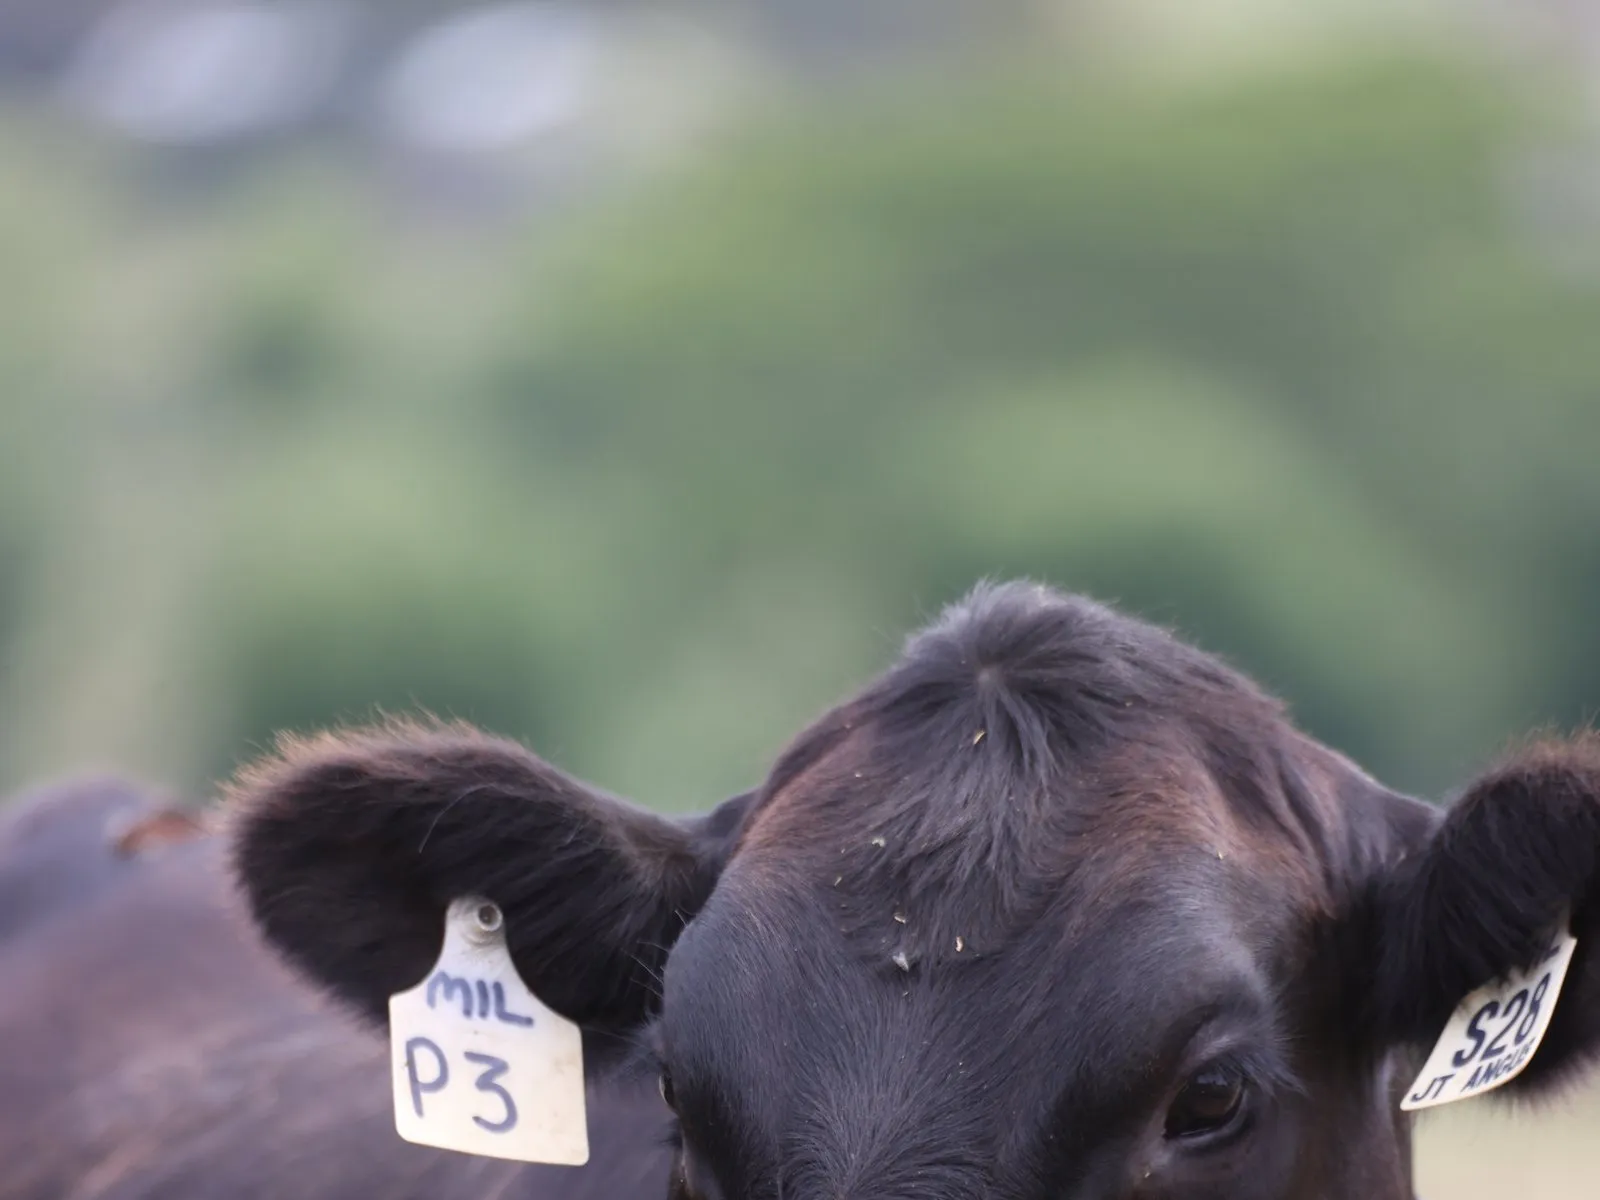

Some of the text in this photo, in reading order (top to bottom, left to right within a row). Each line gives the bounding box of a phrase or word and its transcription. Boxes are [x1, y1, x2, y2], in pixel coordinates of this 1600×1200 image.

[427, 971, 534, 1027] MIL
[1452, 972, 1551, 1067] S28
[1410, 1073, 1456, 1103] JT
